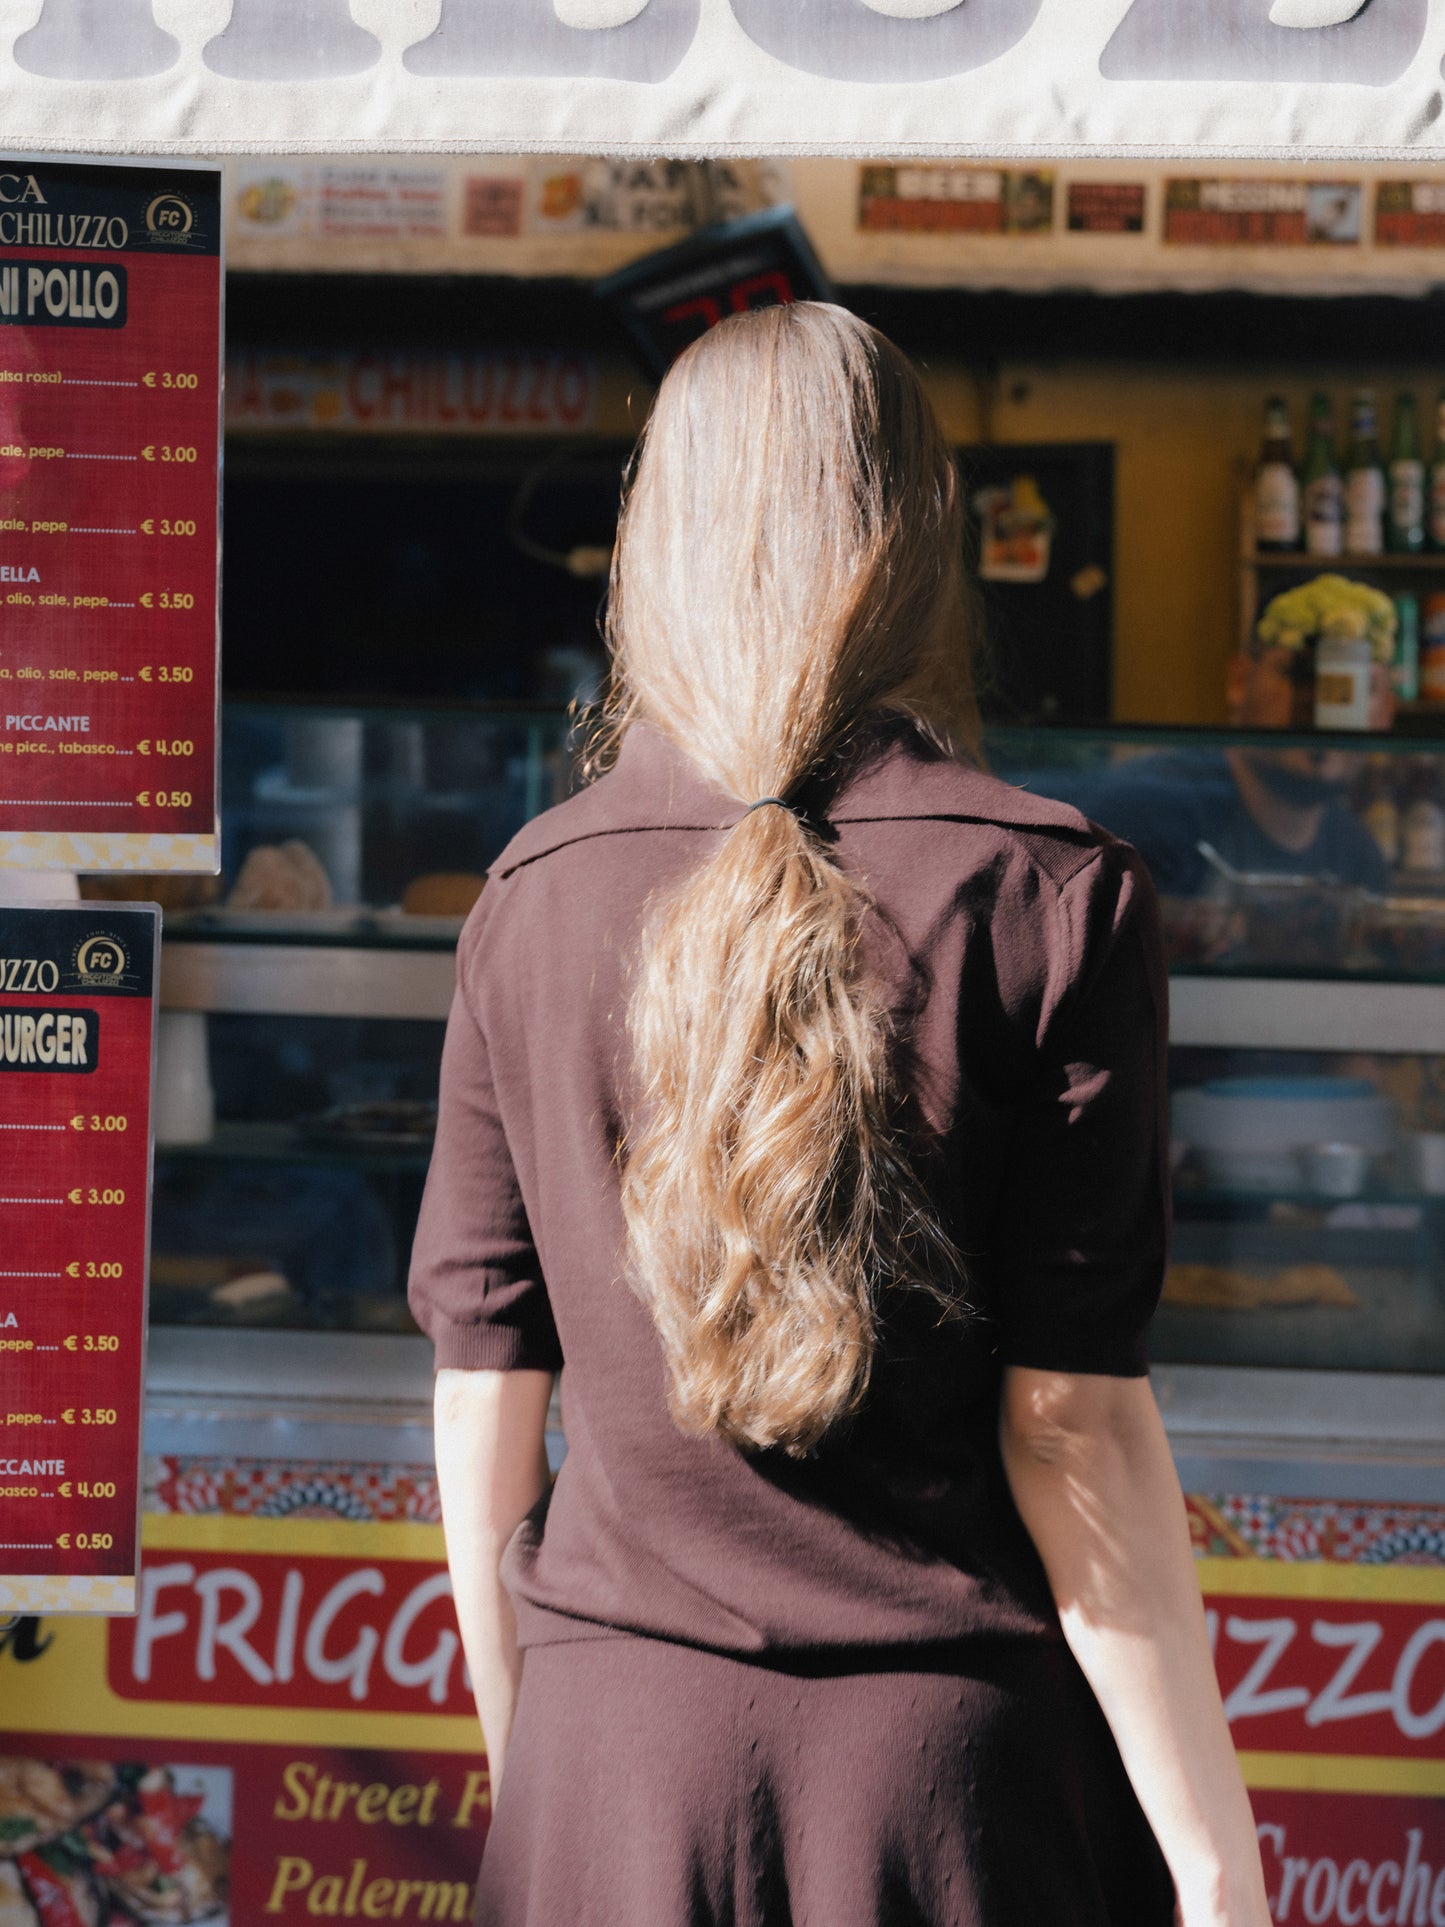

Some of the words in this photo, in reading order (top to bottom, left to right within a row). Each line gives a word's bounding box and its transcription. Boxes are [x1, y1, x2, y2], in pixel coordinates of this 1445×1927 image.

[158, 209, 180, 227] FC
[0, 211, 129, 249] CHILUZZO
[27, 267, 120, 320] POLLO
[26, 371, 61, 383] rosa)
[143, 372, 156, 387] €
[162, 373, 197, 388] 3.00
[346, 357, 592, 423] CHILUZZO
[0, 445, 26, 459] ale,
[29, 447, 64, 459] pepe
[142, 446, 155, 461] €
[161, 446, 196, 462] 3.00
[32, 522, 67, 533] pepe
[141, 519, 154, 534] €
[160, 520, 196, 535] 3.00
[0, 566, 41, 584] ELLA
[7, 593, 35, 605] olio,
[39, 594, 70, 606] sale,
[74, 597, 108, 608] pepe
[140, 593, 153, 608] €
[159, 593, 193, 608] 3.50
[17, 667, 44, 680] olio,
[49, 668, 80, 680] sale,
[84, 671, 118, 682] pepe
[139, 666, 152, 681] €
[159, 667, 193, 682] 3.50
[6, 715, 89, 731] PICCANTE
[59, 742, 115, 754] tabasco
[137, 740, 150, 755] €
[156, 740, 193, 755] 4.00
[136, 791, 150, 806] €
[156, 792, 191, 807] 0.50
[89, 951, 113, 969] FC
[71, 1116, 84, 1130] €
[90, 1115, 127, 1131] 3.00
[68, 1189, 82, 1204] €
[88, 1189, 124, 1204] 3.00
[66, 1262, 79, 1277] €
[86, 1262, 122, 1278] 3.00
[0, 1339, 34, 1352] pepe
[64, 1335, 77, 1350] €
[84, 1336, 119, 1351] 3.50
[7, 1414, 42, 1425] pepe
[61, 1409, 75, 1424] €
[81, 1409, 116, 1424] 3.50
[58, 1482, 72, 1497] €
[78, 1482, 115, 1497] 4.00
[56, 1534, 70, 1549] €
[76, 1534, 112, 1549] 0.50
[133, 1563, 474, 1703] FRIGG
[1201, 1609, 1445, 1740] ZZO
[274, 1761, 441, 1828] Street
[265, 1856, 478, 1923] Palerm
